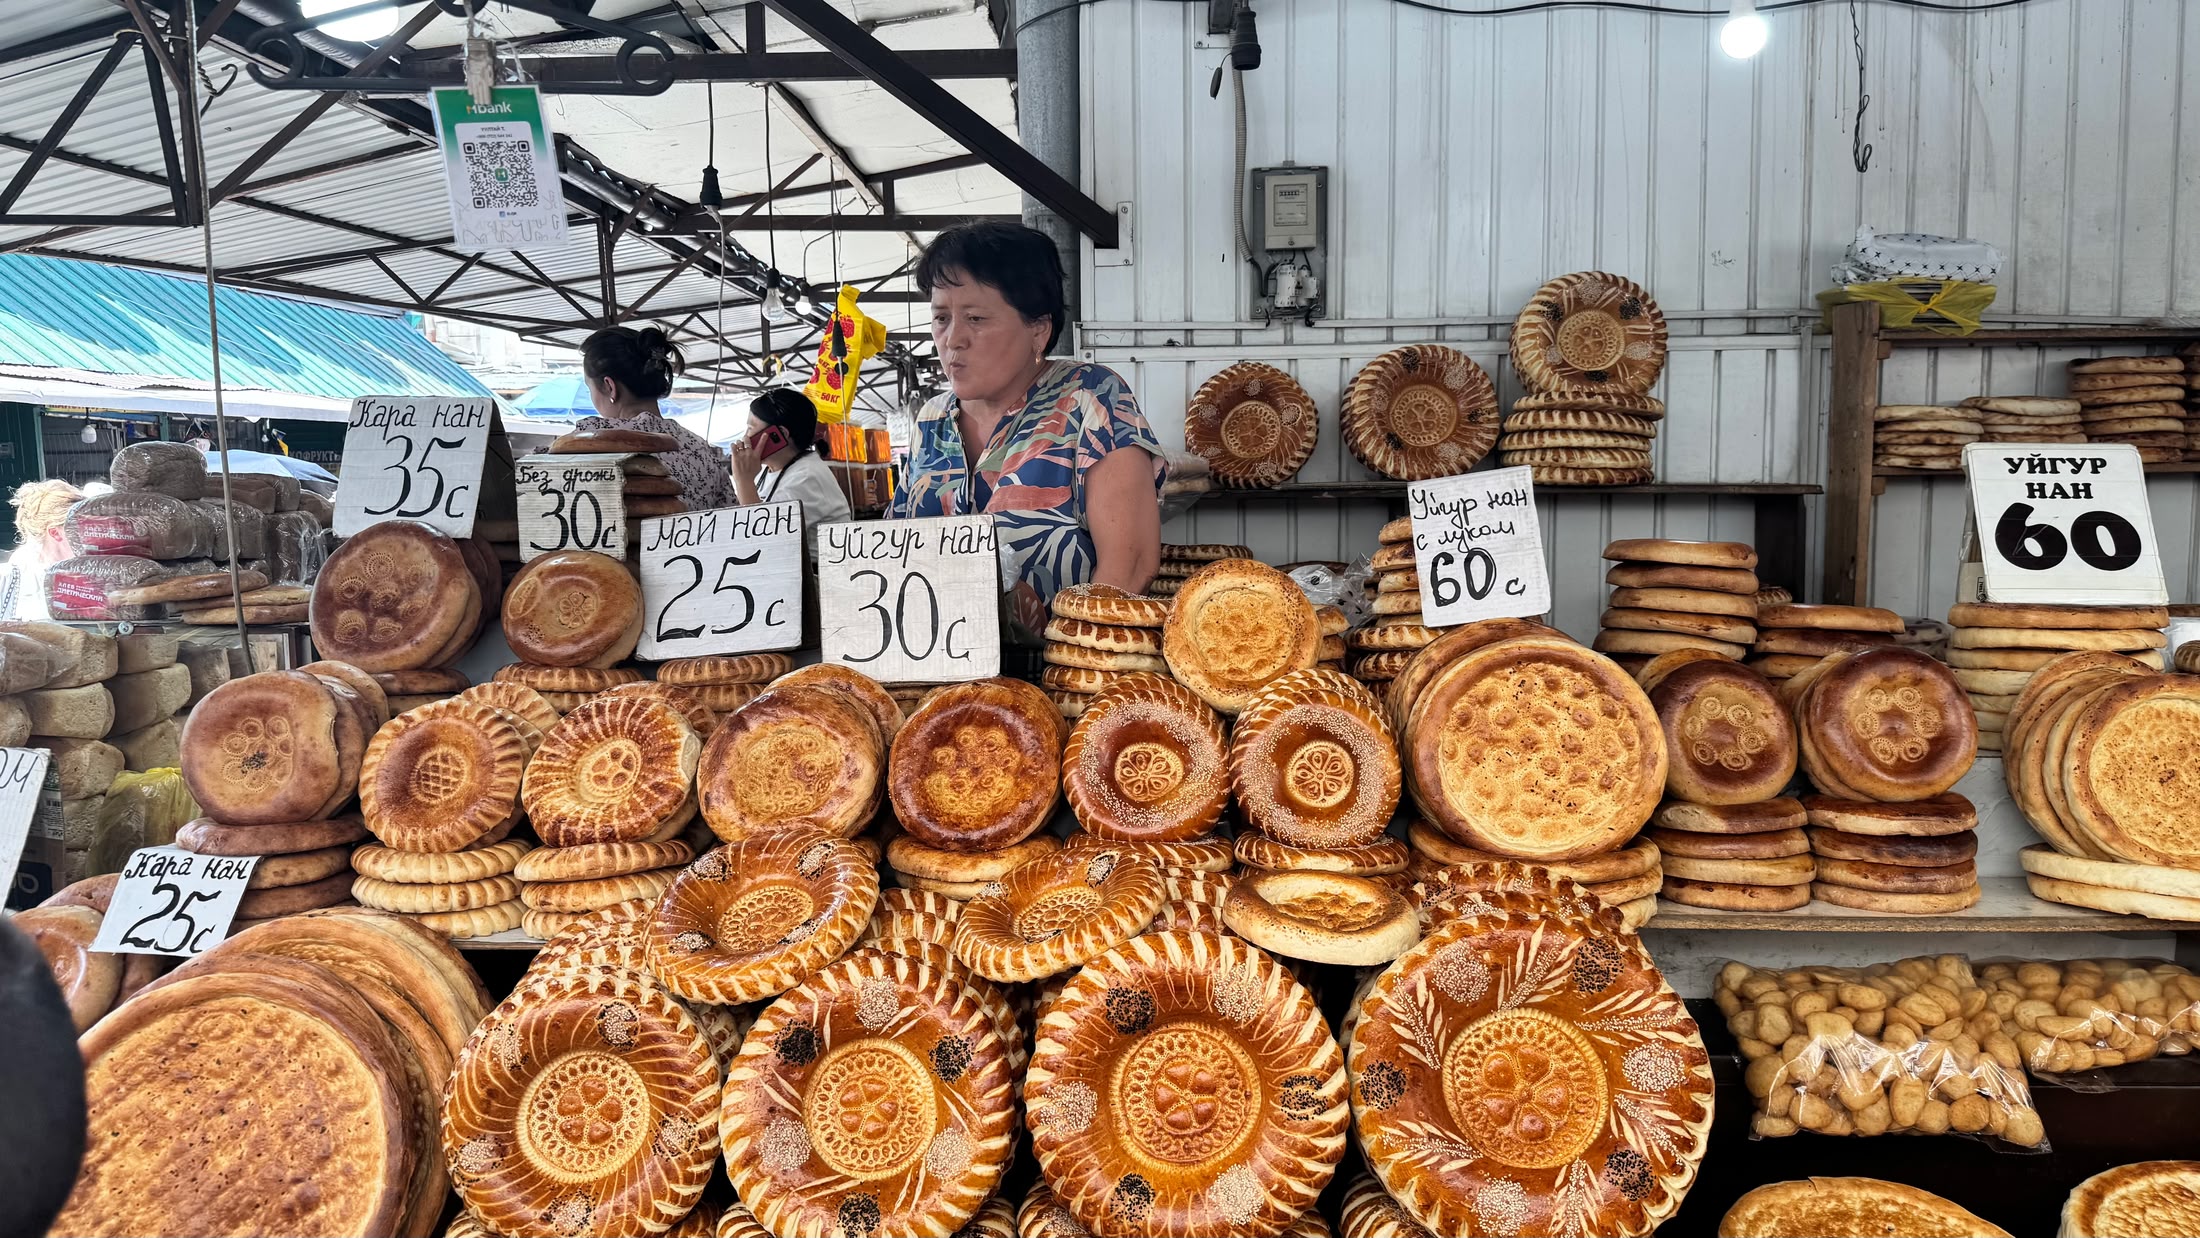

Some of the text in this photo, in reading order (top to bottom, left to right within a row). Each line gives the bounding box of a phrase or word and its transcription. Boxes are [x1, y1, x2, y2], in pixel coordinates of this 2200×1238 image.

[349, 400, 486, 440] Кара нан
[516, 465, 552, 488] Без
[2003, 453, 2107, 474] УЙГУР
[1487, 488, 1528, 510] нан
[2025, 482, 2094, 499] НАН
[731, 507, 798, 540] нан
[1438, 521, 1515, 554] луком
[1994, 502, 2142, 571] 60
[939, 525, 998, 556] нан
[125, 853, 249, 886] Кара нан
